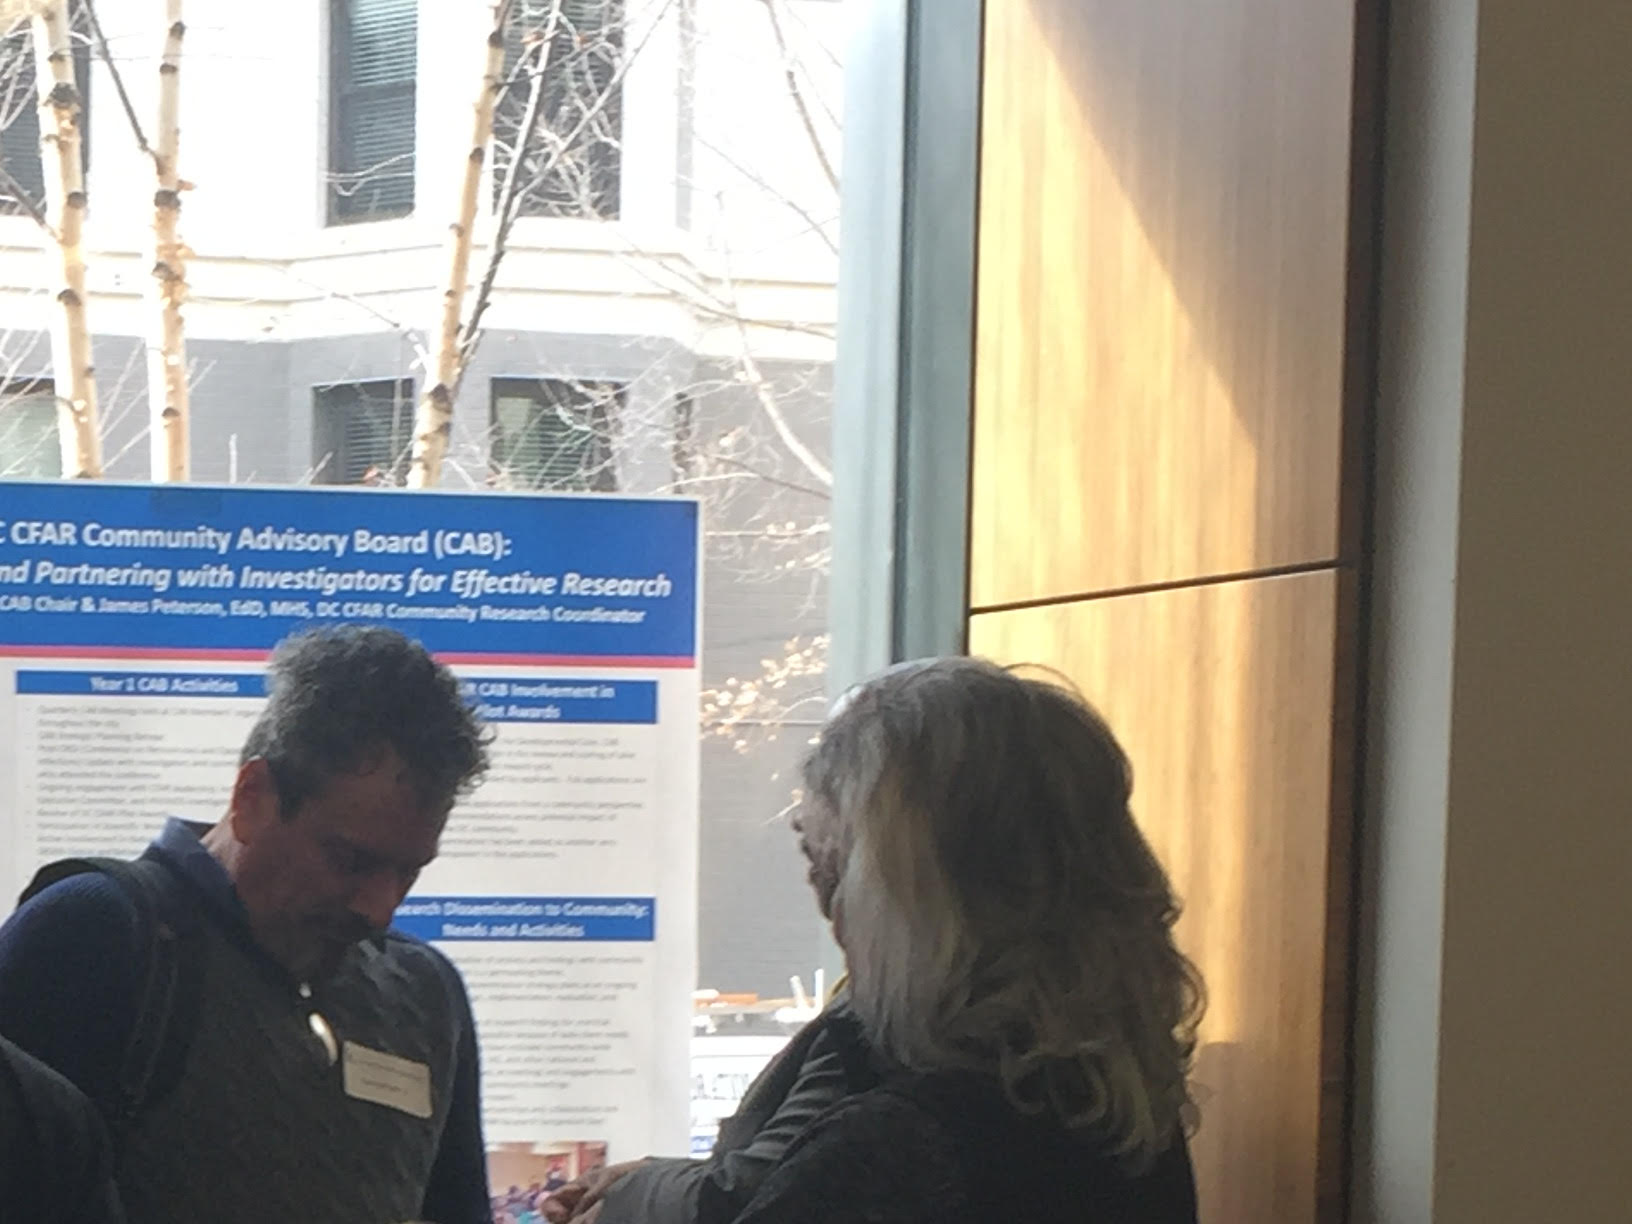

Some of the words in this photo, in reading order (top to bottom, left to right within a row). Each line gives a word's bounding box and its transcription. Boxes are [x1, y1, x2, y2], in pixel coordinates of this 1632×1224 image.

[10, 522, 77, 545] CFAR
[82, 523, 232, 554] Community
[236, 527, 348, 557] Advisory
[354, 529, 428, 554] Board
[434, 530, 512, 560] (CAB):
[34, 561, 171, 592] Partnering
[177, 565, 234, 587] with
[239, 566, 404, 595] Investigators
[405, 568, 447, 597] for
[450, 569, 557, 598] Effective
[561, 573, 672, 597] Research
[34, 596, 78, 611] Chair
[80, 597, 95, 612] &
[98, 598, 149, 613] James
[316, 602, 340, 617] DC
[342, 602, 385, 617] CFAR
[386, 603, 478, 622] Community
[480, 605, 550, 621] Research
[552, 606, 647, 623] Coordinator
[90, 676, 123, 691] Year
[125, 677, 136, 691] 1
[137, 677, 167, 692] CAB
[171, 677, 239, 693] Activities
[478, 683, 508, 697] CAB
[511, 683, 598, 698] Involvement
[599, 685, 616, 698] in
[507, 704, 561, 719] Awards
[443, 901, 543, 916] Dissemination
[545, 902, 561, 916] to
[442, 923, 488, 937] Needs
[490, 922, 518, 937] and
[519, 922, 585, 938] Activities
